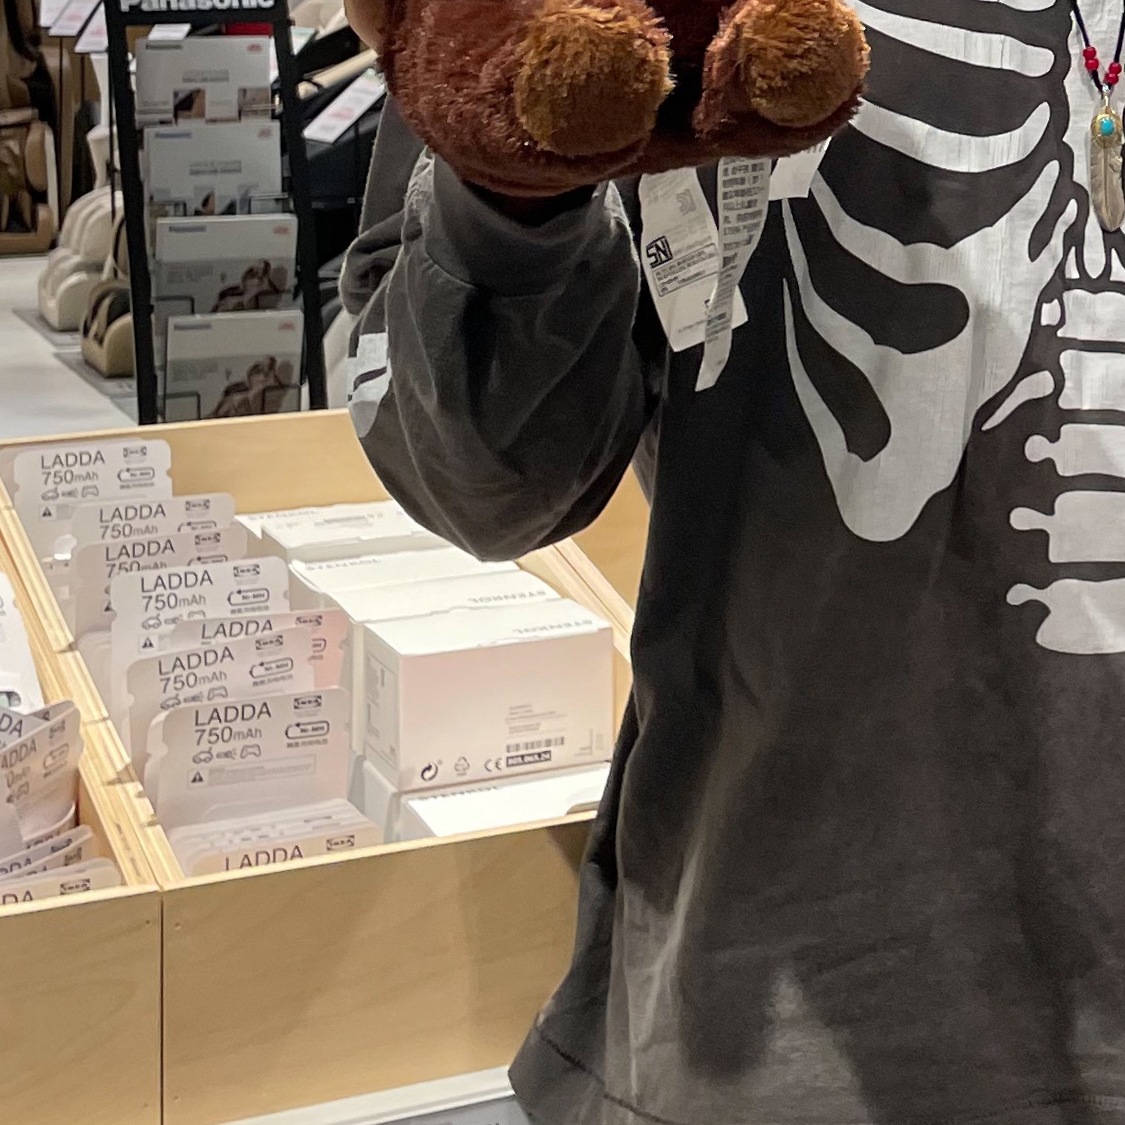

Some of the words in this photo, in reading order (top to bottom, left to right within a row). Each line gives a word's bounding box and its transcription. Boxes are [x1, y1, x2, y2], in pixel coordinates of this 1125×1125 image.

[41, 450, 105, 470] LADDA
[100, 503, 166, 523] LADDA
[106, 539, 175, 561] LADDA
[140, 569, 213, 593] LADDA
[201, 619, 273, 640] LADDA
[158, 646, 235, 676] LADDA
[194, 701, 272, 726] LADDA
[0, 738, 37, 770] ADDA
[225, 845, 304, 872] LADDA
